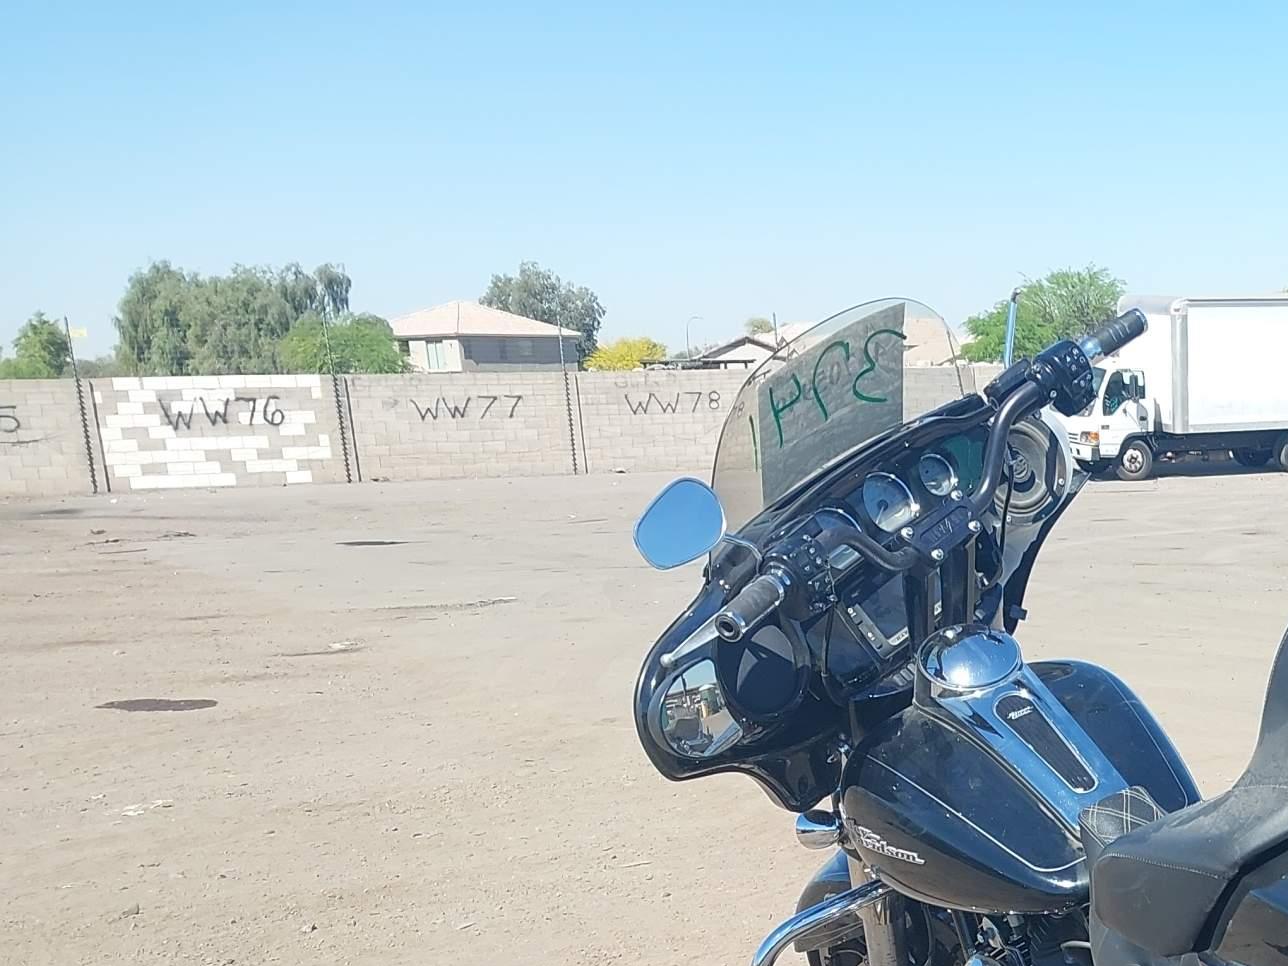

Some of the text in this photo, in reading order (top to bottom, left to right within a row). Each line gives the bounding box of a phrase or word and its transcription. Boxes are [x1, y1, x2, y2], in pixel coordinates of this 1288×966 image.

[158, 396, 285, 431] WW76
[410, 395, 523, 421] WW77
[625, 390, 720, 415] WW78
